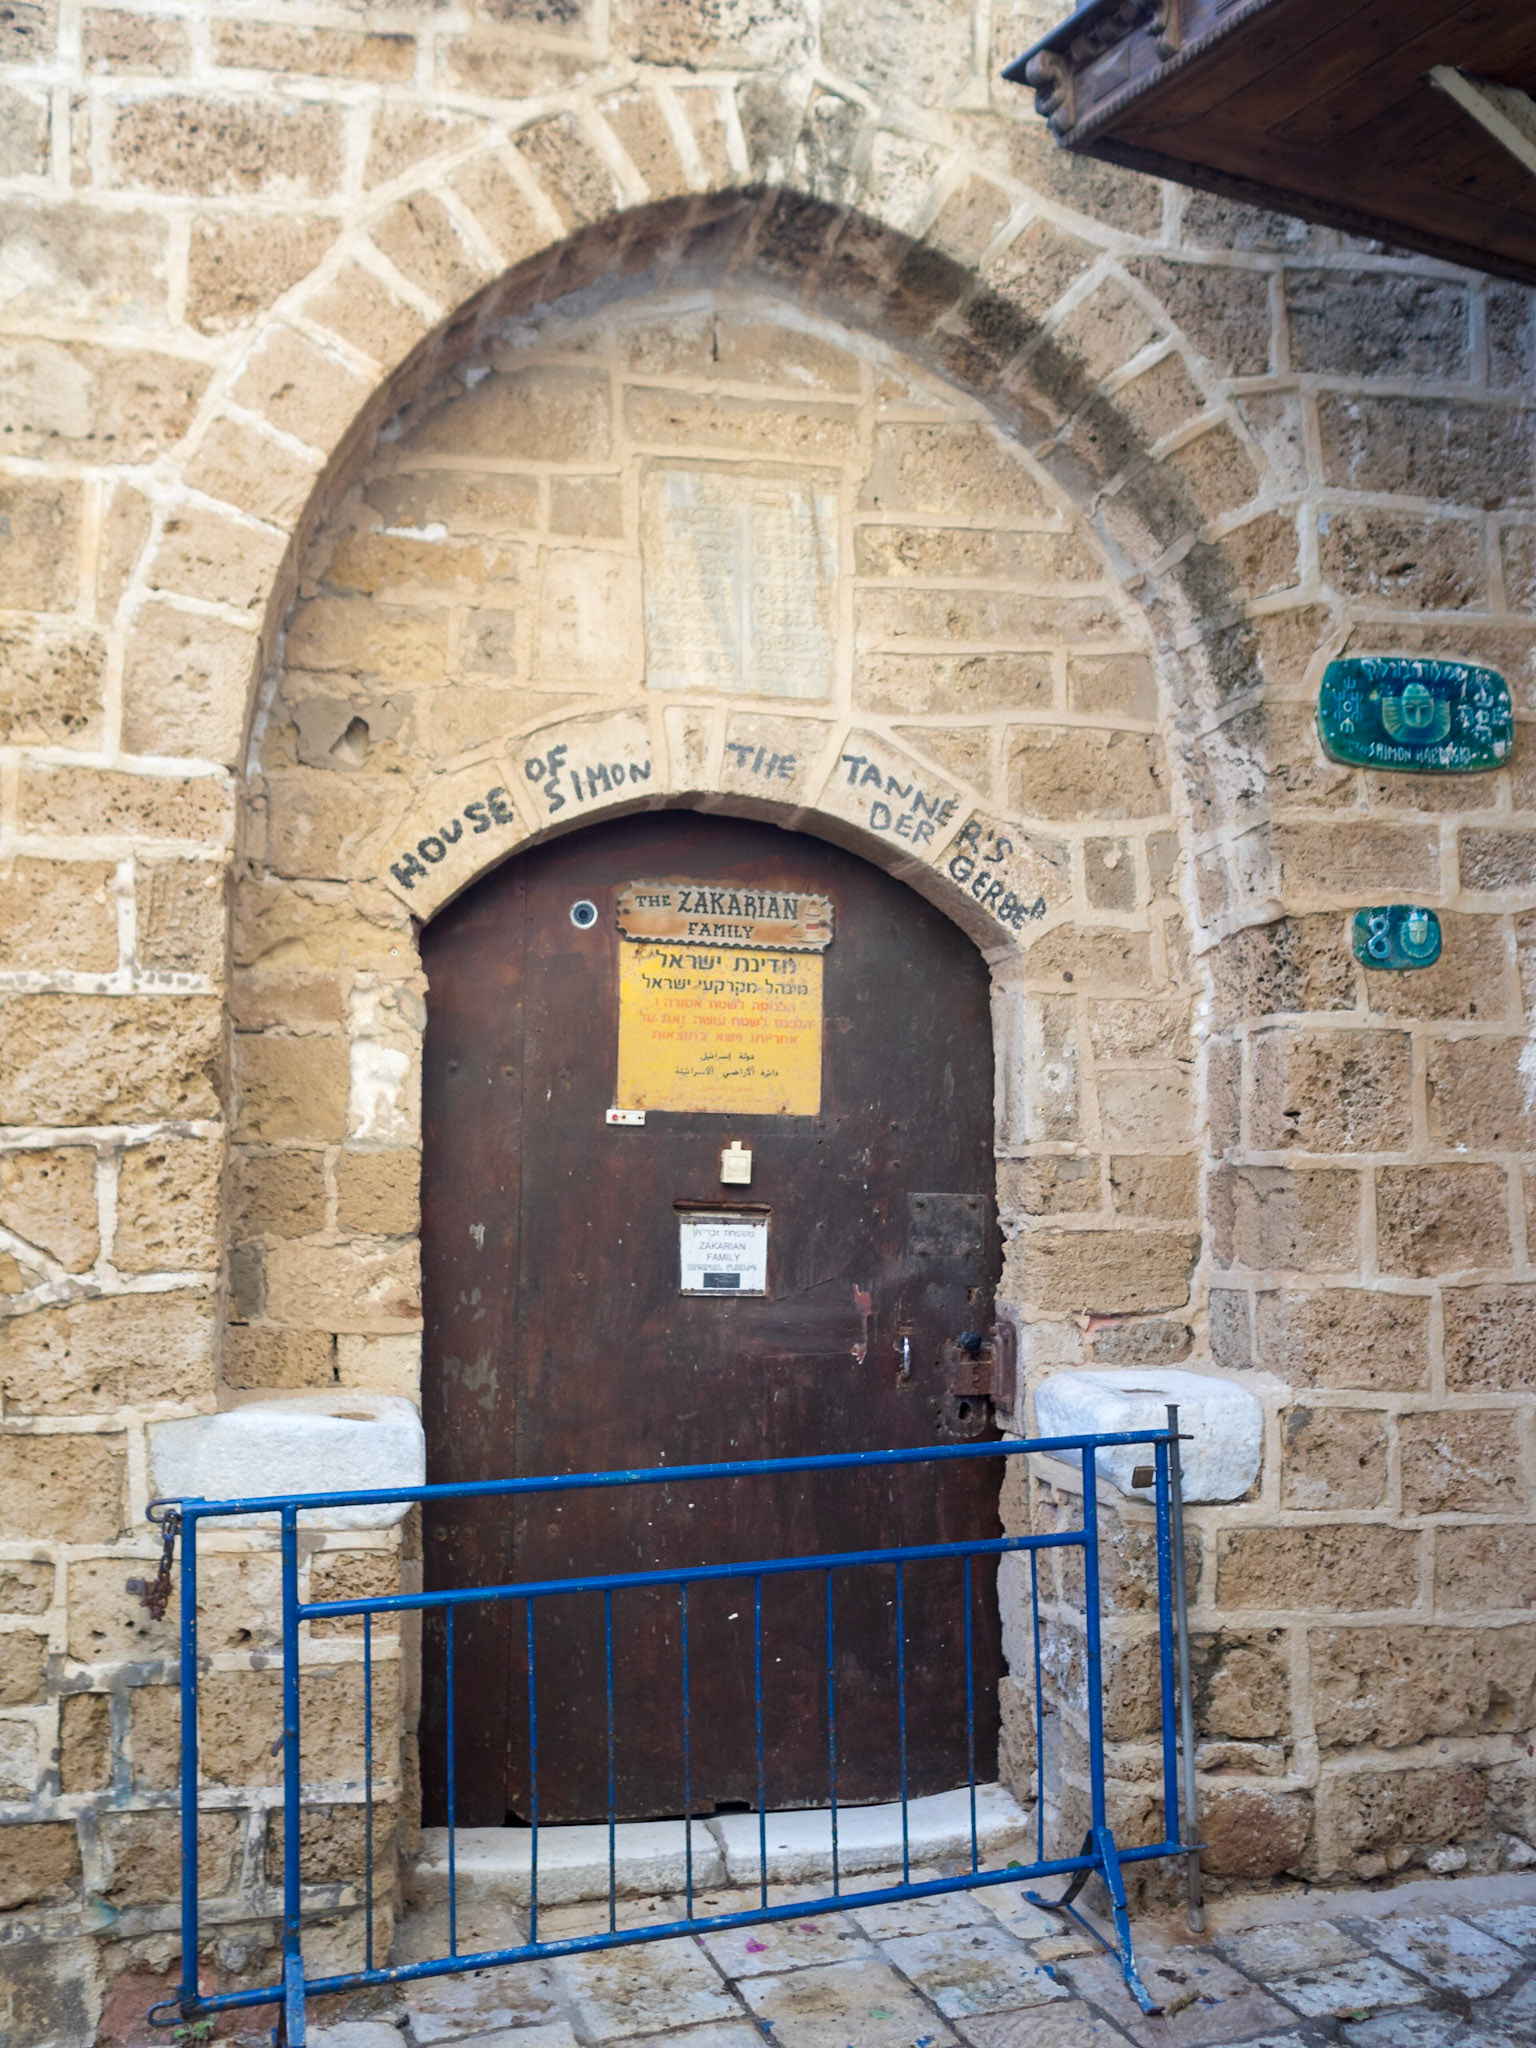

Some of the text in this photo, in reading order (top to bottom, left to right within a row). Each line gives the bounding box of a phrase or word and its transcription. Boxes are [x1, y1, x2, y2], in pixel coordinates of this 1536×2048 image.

[524, 744, 568, 783] OF
[728, 742, 797, 780] THE
[1368, 741, 1411, 762] SHIMON
[543, 759, 652, 814] SIMON
[390, 786, 514, 890] HOUSE
[869, 800, 1047, 931] DER GERBER
[635, 890, 799, 920] THE ZAKARIAN
[688, 921, 754, 939] FAMILY
[656, 950, 797, 974] מדינת ישראל
[642, 974, 808, 996] מינהל מקרקעי ישראל
[699, 1241, 747, 1250] ZAKARIAN
[706, 1253, 740, 1261] FAMILY
